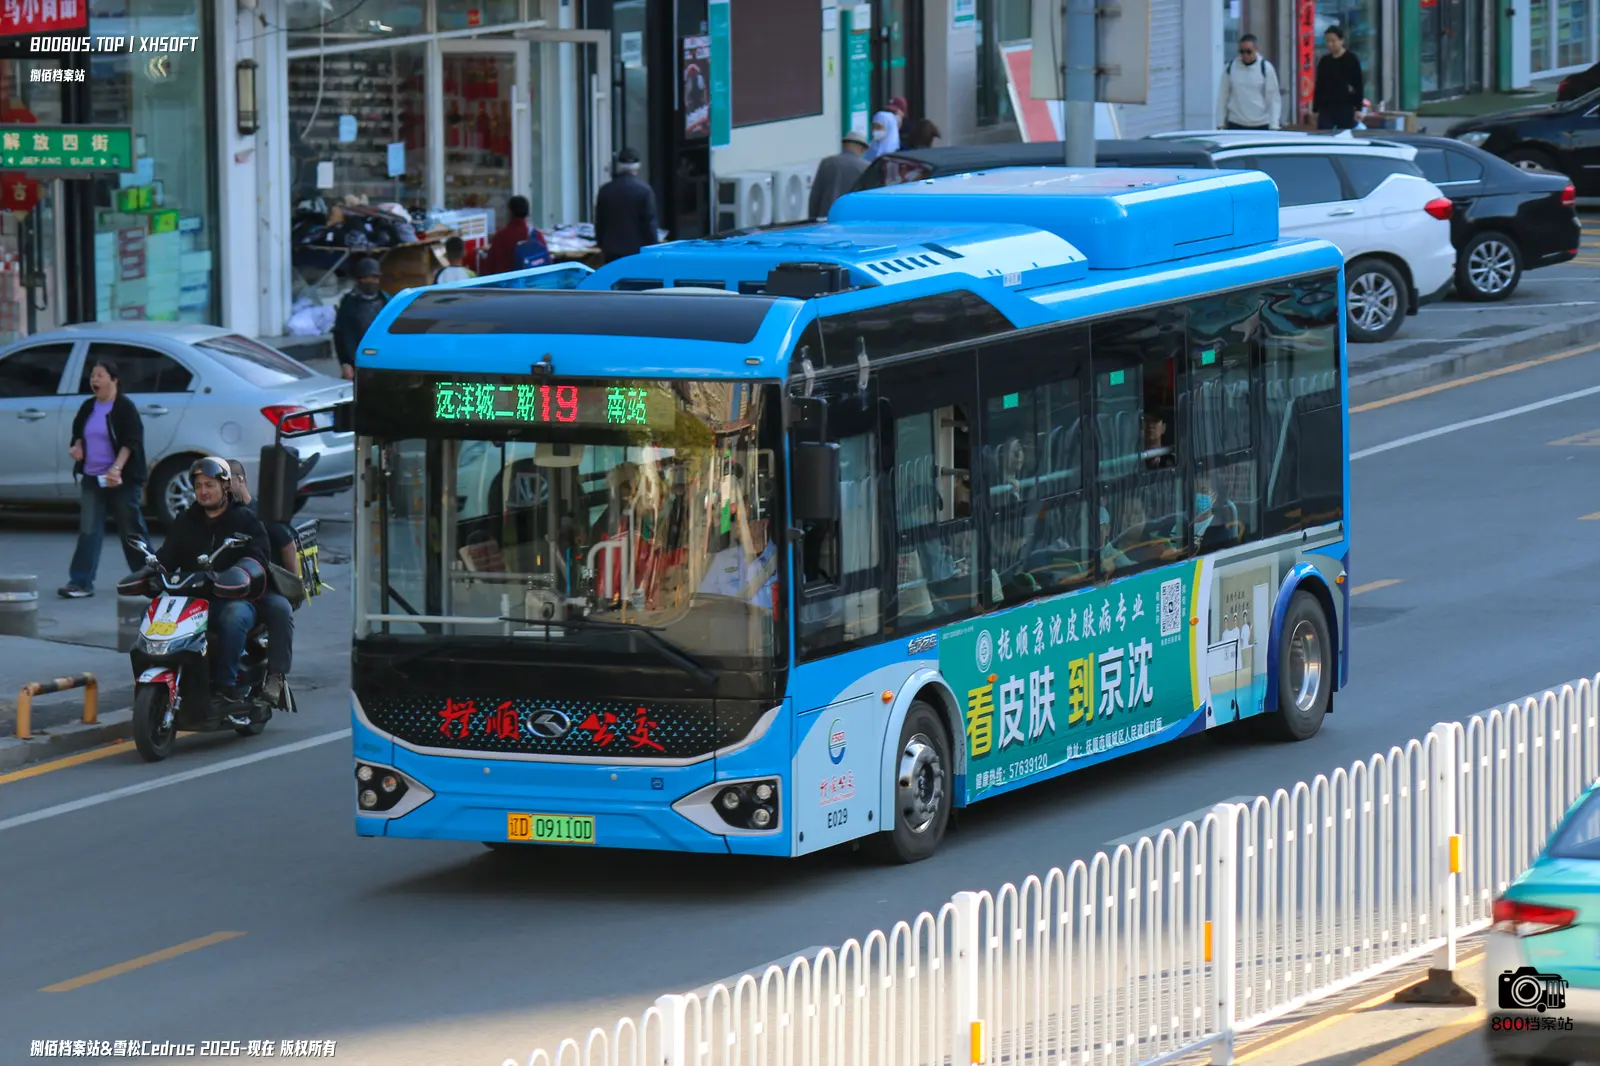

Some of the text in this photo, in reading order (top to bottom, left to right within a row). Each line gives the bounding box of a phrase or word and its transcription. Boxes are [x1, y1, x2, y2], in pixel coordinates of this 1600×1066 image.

[3, 133, 109, 152] 解放四街
[540, 385, 578, 422] 19
[607, 387, 648, 424] 南站
[997, 592, 1145, 662] 抚顺京沈皮肤病专业
[966, 636, 1153, 757] 看皮肤 到京沈
[578, 707, 665, 751] 公交
[827, 807, 848, 829] E029
